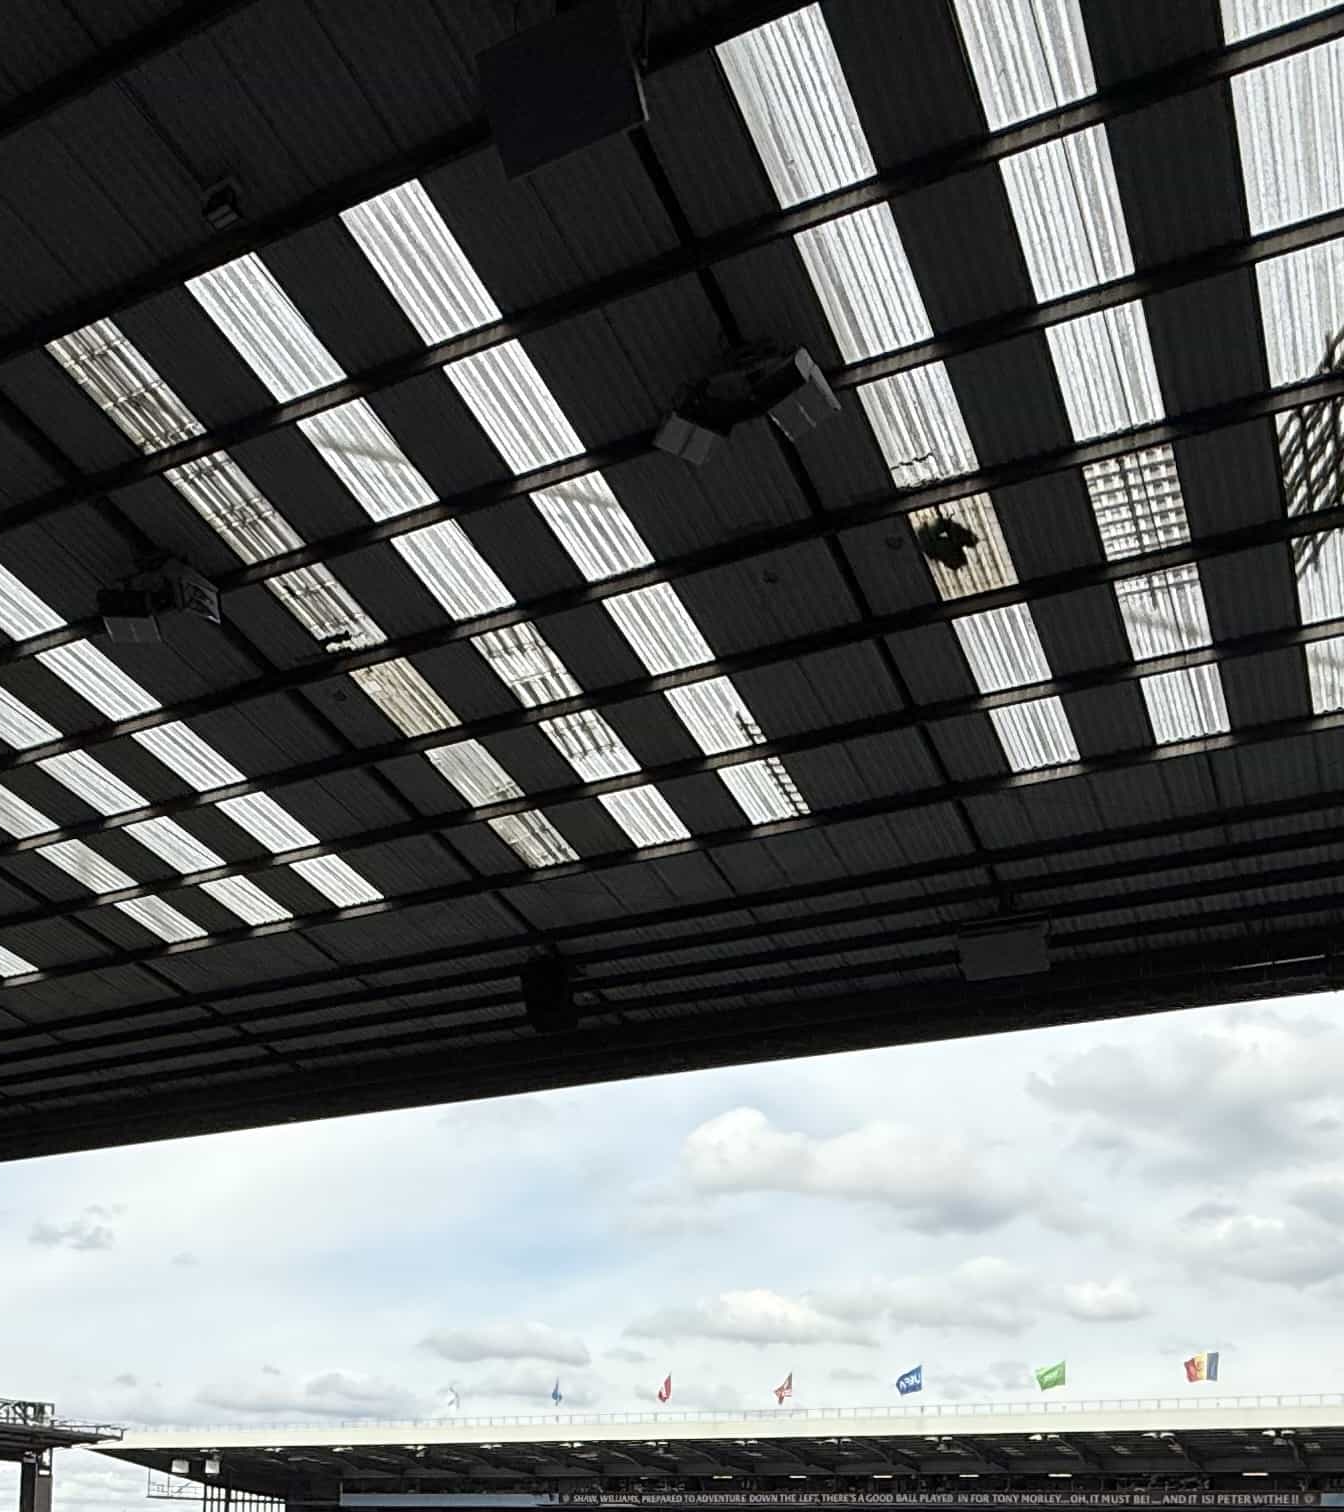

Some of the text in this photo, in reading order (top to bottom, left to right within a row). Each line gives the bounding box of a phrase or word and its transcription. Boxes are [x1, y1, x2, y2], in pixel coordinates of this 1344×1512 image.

[642, 1494, 682, 1504] PREPARED
[684, 1494, 695, 1504] TO
[696, 1494, 746, 1504] ADVENTURE
[749, 1494, 778, 1504] DOWN
[780, 1494, 797, 1504] THE
[865, 1494, 894, 1504] GOOD
[896, 1494, 918, 1504] BALL
[919, 1494, 954, 1504] PLAYED
[958, 1494, 969, 1504] IN
[971, 1494, 990, 1504] FOR
[992, 1494, 1019, 1504] TONY
[1101, 1494, 1130, 1504] MUST
[1188, 1494, 1198, 1504] IT
[1217, 1494, 1252, 1504] PETER
[1252, 1494, 1289, 1504] WITHE
